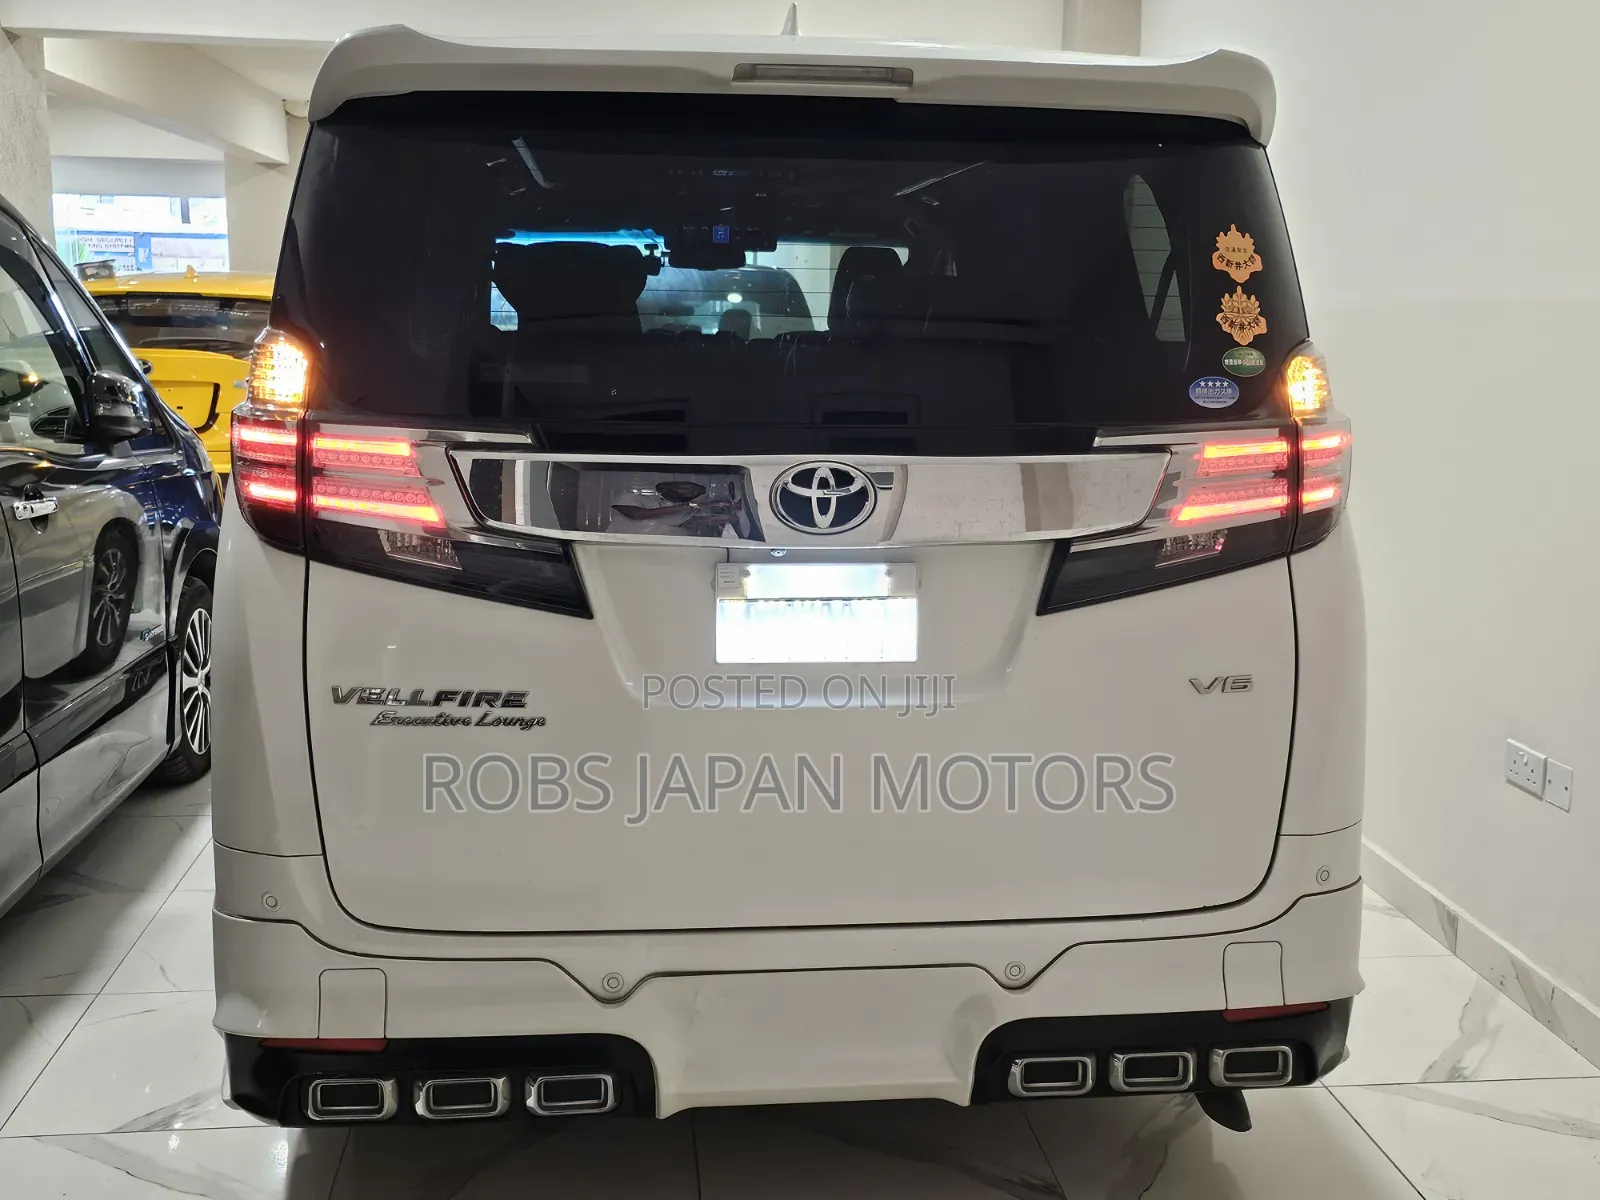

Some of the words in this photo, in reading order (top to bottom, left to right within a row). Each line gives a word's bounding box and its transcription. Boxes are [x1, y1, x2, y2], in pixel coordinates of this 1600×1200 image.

[1188, 674, 1254, 695] V6
[331, 685, 531, 708] VELLFIRE
[370, 710, 473, 727] Executive
[473, 711, 547, 731] Lounge
